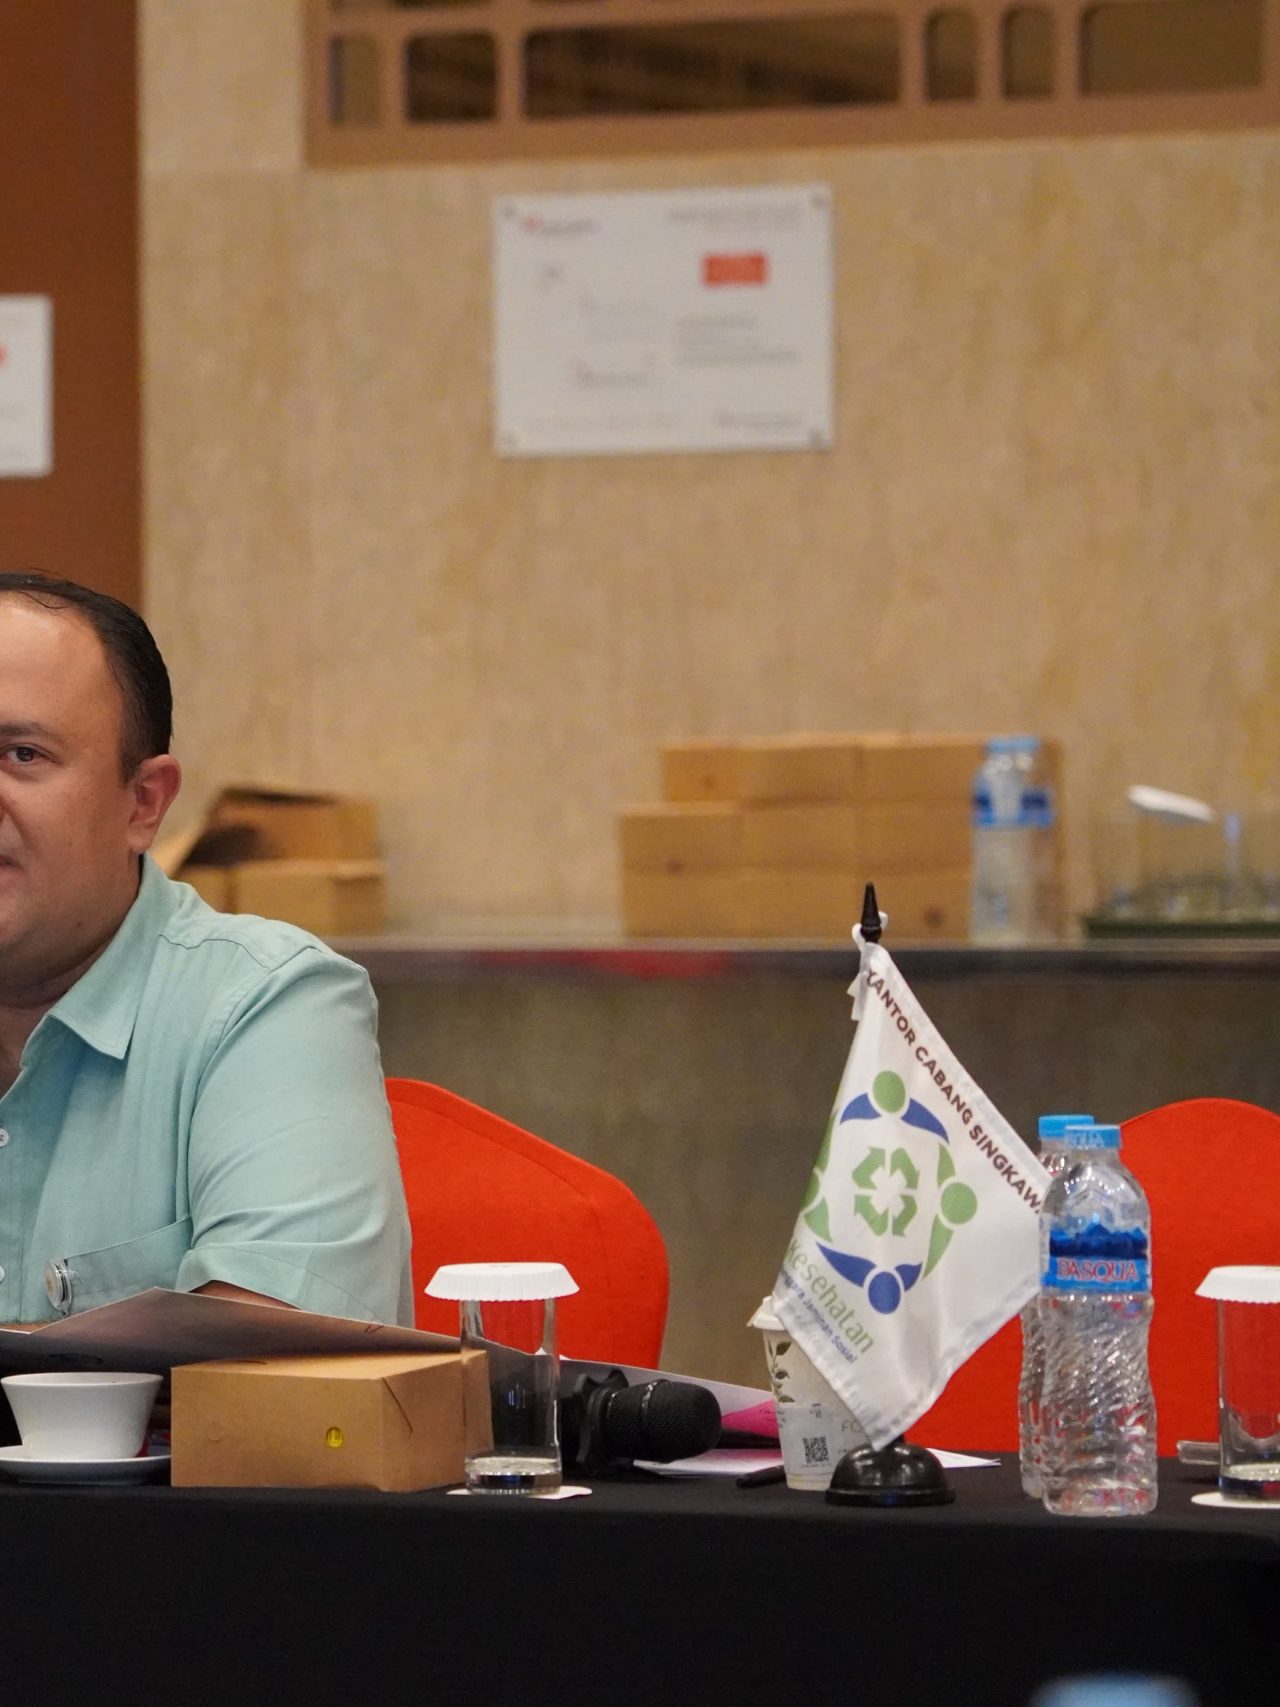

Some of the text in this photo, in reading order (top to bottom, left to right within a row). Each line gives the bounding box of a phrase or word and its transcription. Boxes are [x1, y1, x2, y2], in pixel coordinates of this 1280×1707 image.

[915, 1046, 972, 1126] CABANG
[969, 1124, 1041, 1214] SINGKAW
[1057, 1257, 1139, 1283] PASQUA
[831, 1334, 859, 1364] Sosial
